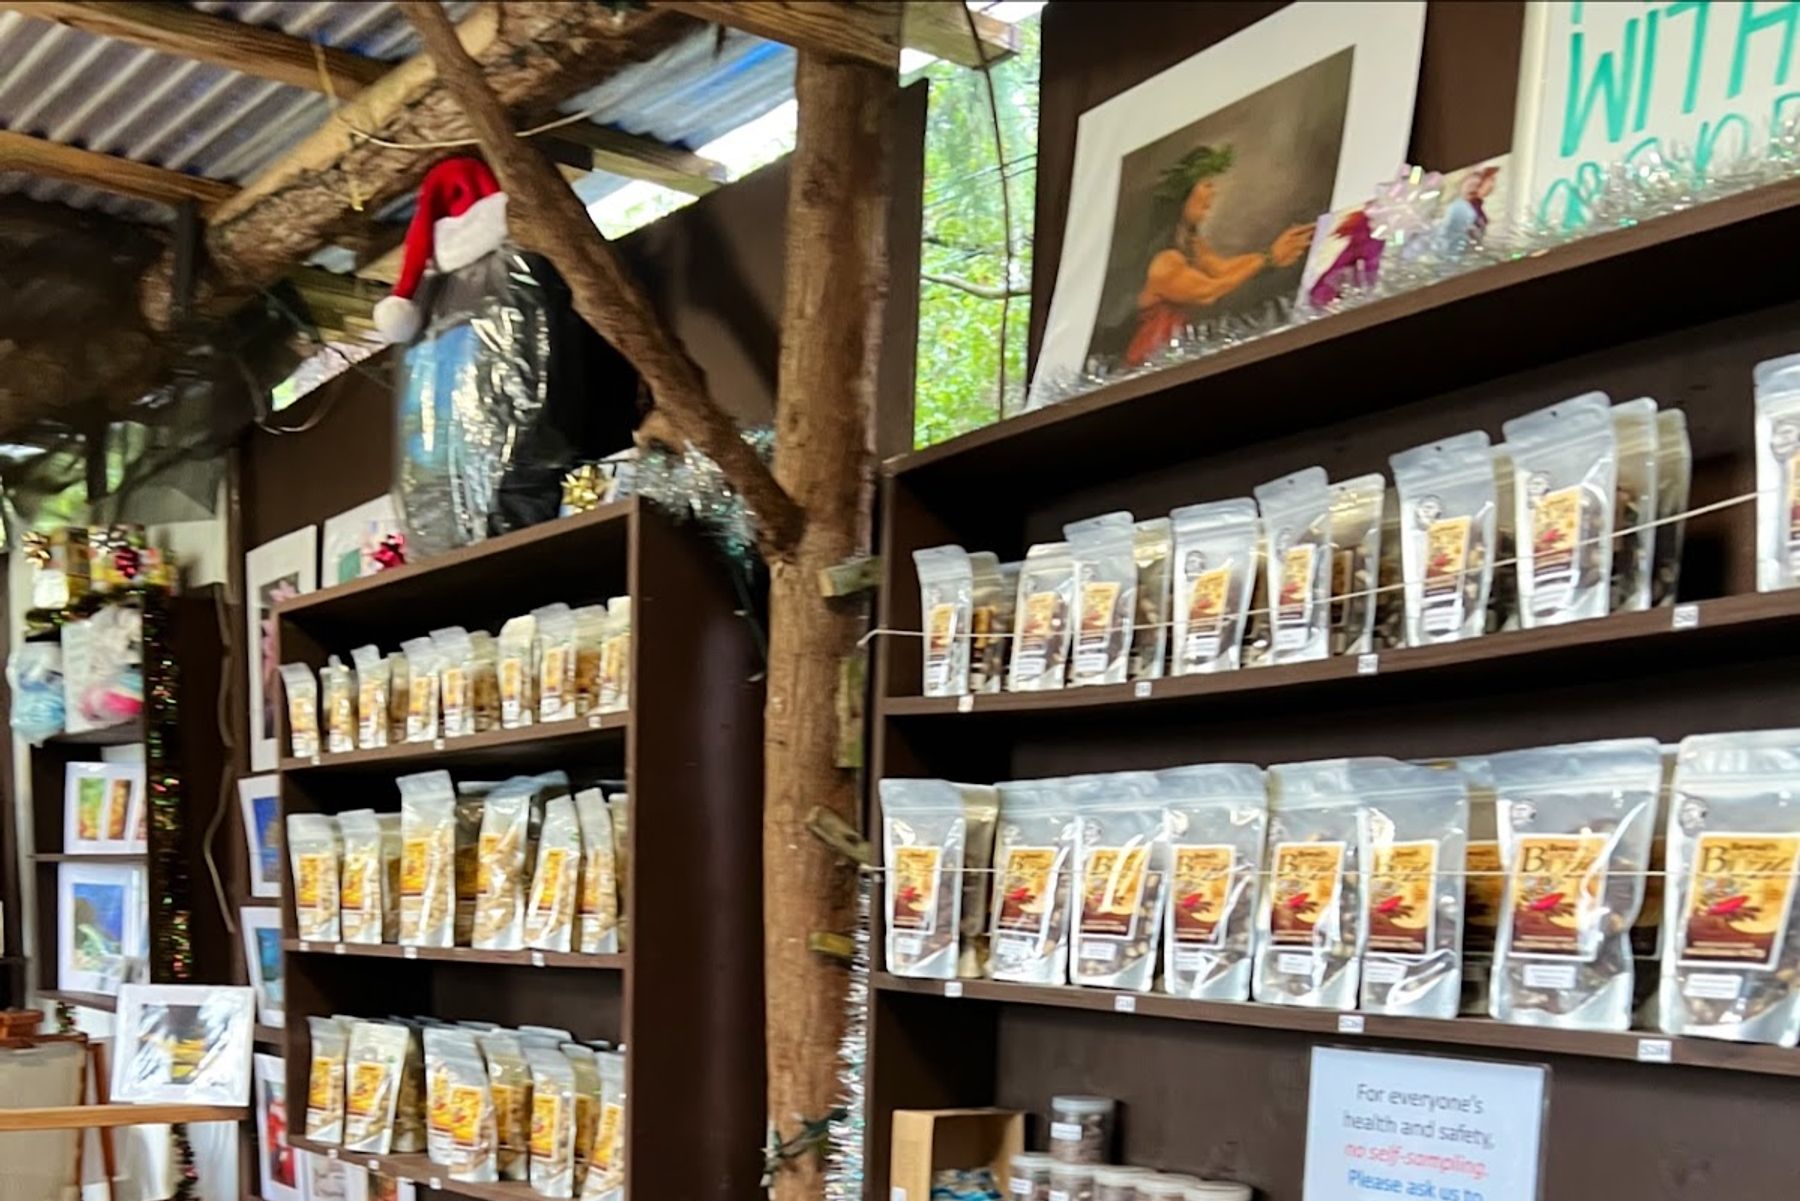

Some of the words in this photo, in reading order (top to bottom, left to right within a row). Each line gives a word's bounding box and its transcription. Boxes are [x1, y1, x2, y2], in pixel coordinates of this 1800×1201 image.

[1357, 1083, 1385, 1102] For
[1388, 1090, 1484, 1114] everyone's
[1343, 1110, 1397, 1133] health
[1400, 1120, 1436, 1138] and
[1345, 1143, 1366, 1158] no
[1349, 1169, 1402, 1193] Please
[1406, 1178, 1436, 1198] ask
